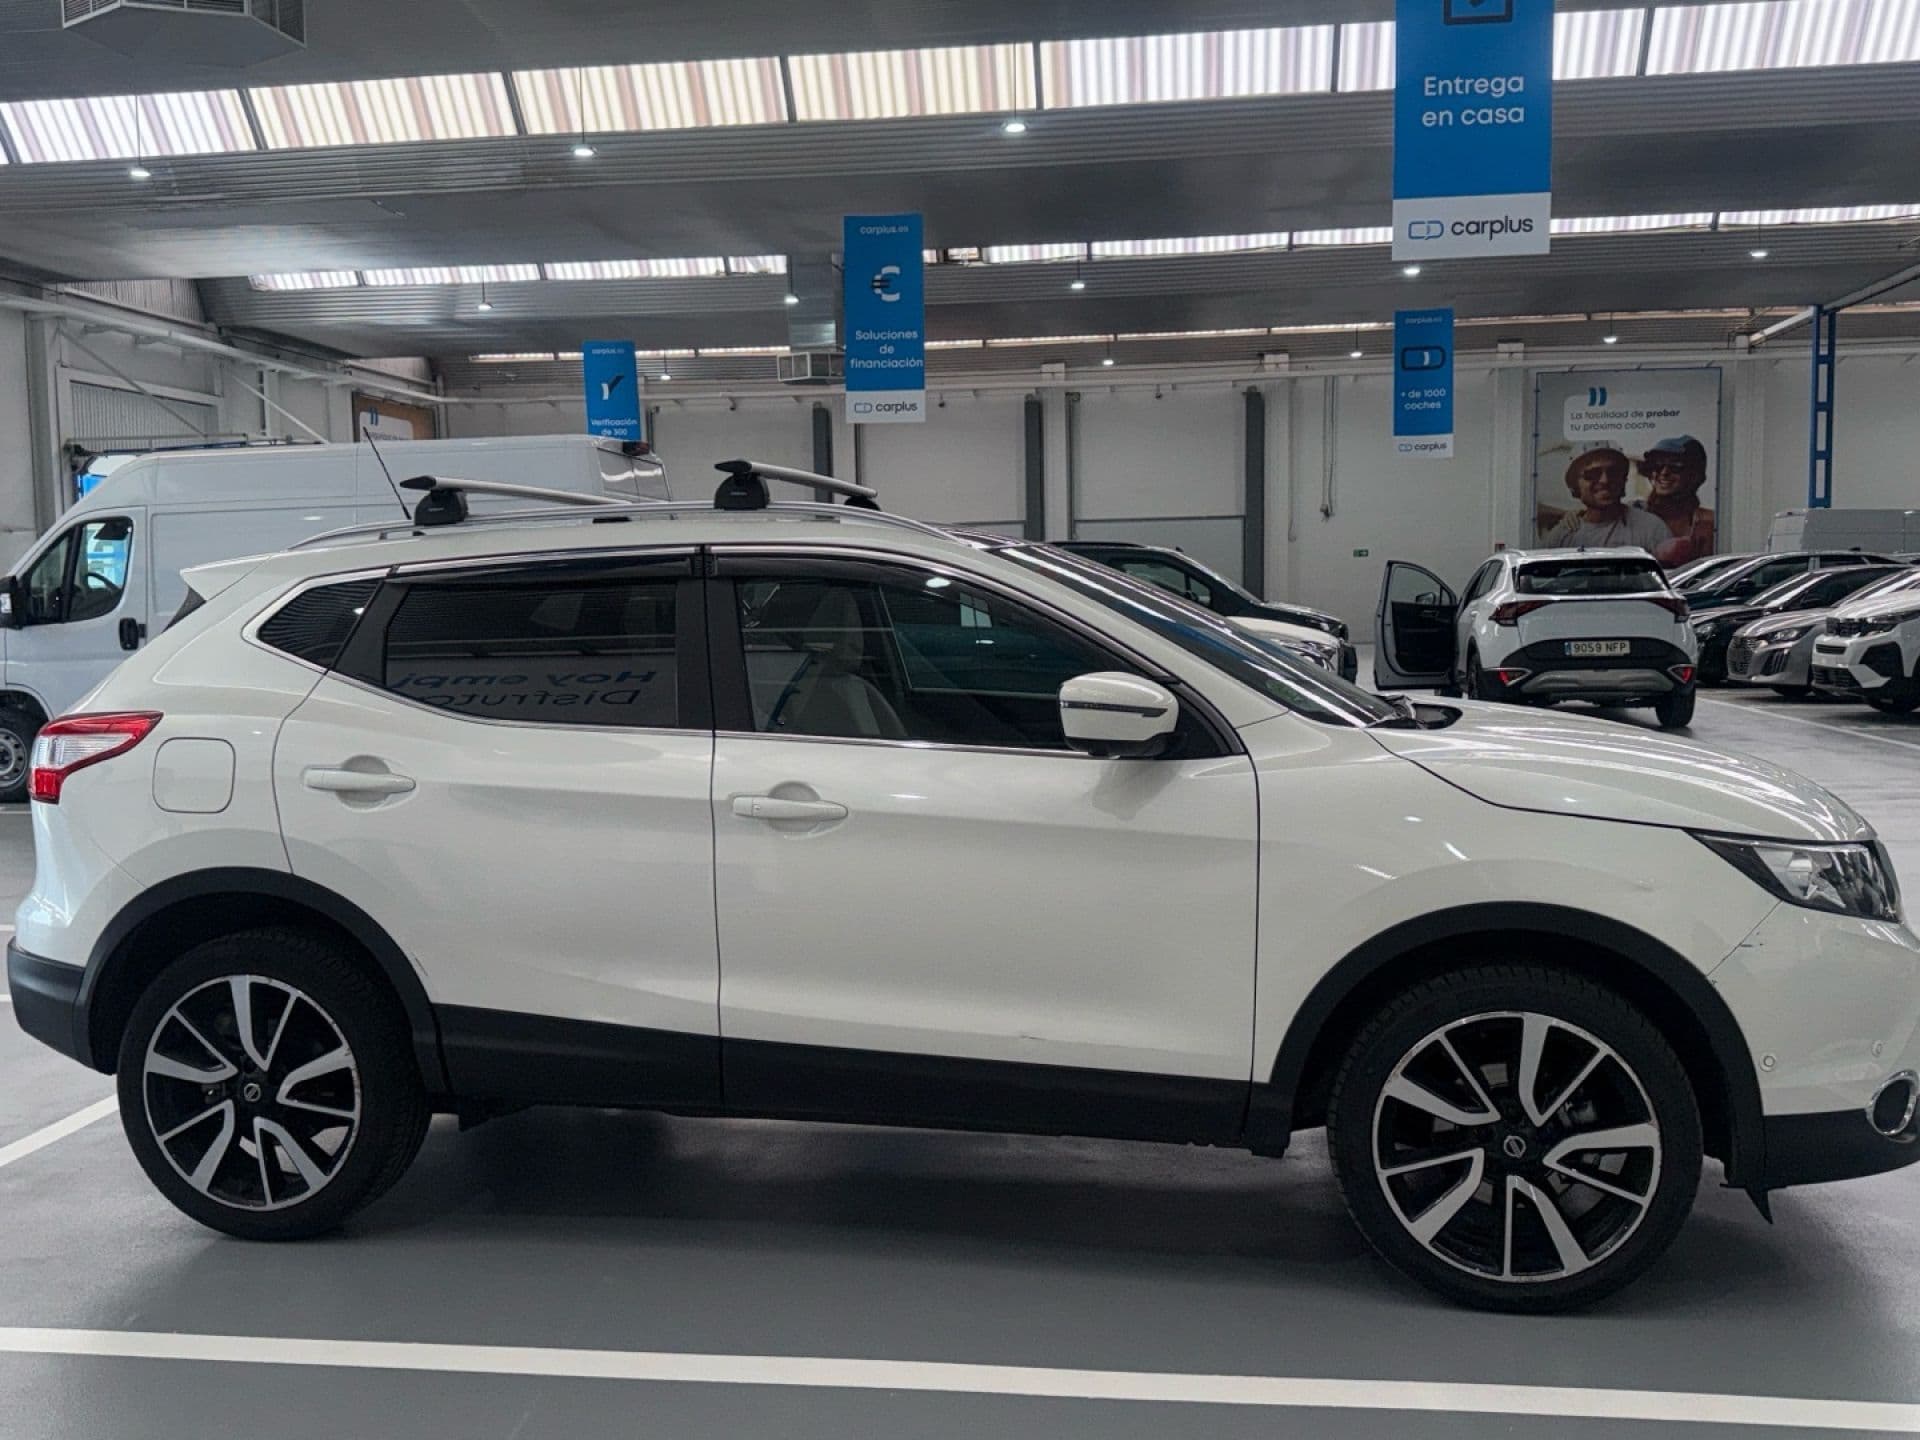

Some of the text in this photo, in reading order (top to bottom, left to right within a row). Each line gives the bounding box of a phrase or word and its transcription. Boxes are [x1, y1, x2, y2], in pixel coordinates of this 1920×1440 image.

[1424, 76, 1524, 98] Entrega
[1422, 106, 1525, 127] en casa
[1451, 215, 1534, 240] carplus
[855, 330, 918, 341] Soluciones
[879, 344, 895, 354] de
[850, 358, 923, 369] financiación
[1408, 389, 1421, 398] de
[1423, 388, 1446, 397] 1000
[876, 401, 918, 414] carplus
[1404, 400, 1441, 410] coches
[1570, 409, 1681, 420] La facilidad de probar
[1570, 423, 1581, 431] tu
[1624, 421, 1656, 430] coche
[1414, 441, 1447, 451] carplus
[1605, 642, 1626, 652] NFP
